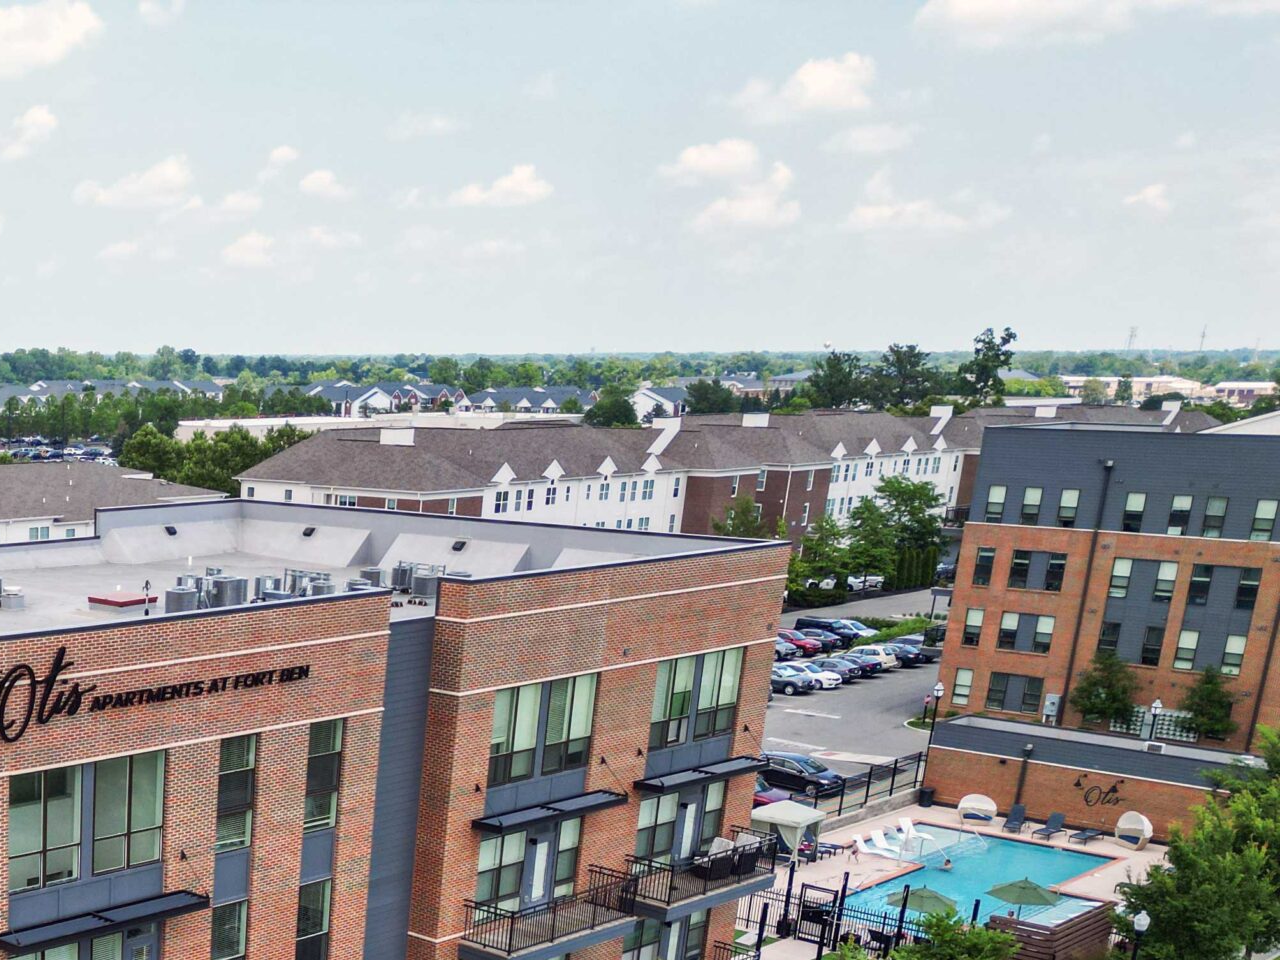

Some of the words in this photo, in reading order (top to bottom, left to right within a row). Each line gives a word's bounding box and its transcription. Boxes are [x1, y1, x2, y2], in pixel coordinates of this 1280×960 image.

[89, 681, 205, 712] APARTMENTS
[208, 676, 231, 694] AT
[234, 669, 277, 690] FORT
[280, 665, 310, 683] BEN
[1084, 785, 1127, 807] Otis
